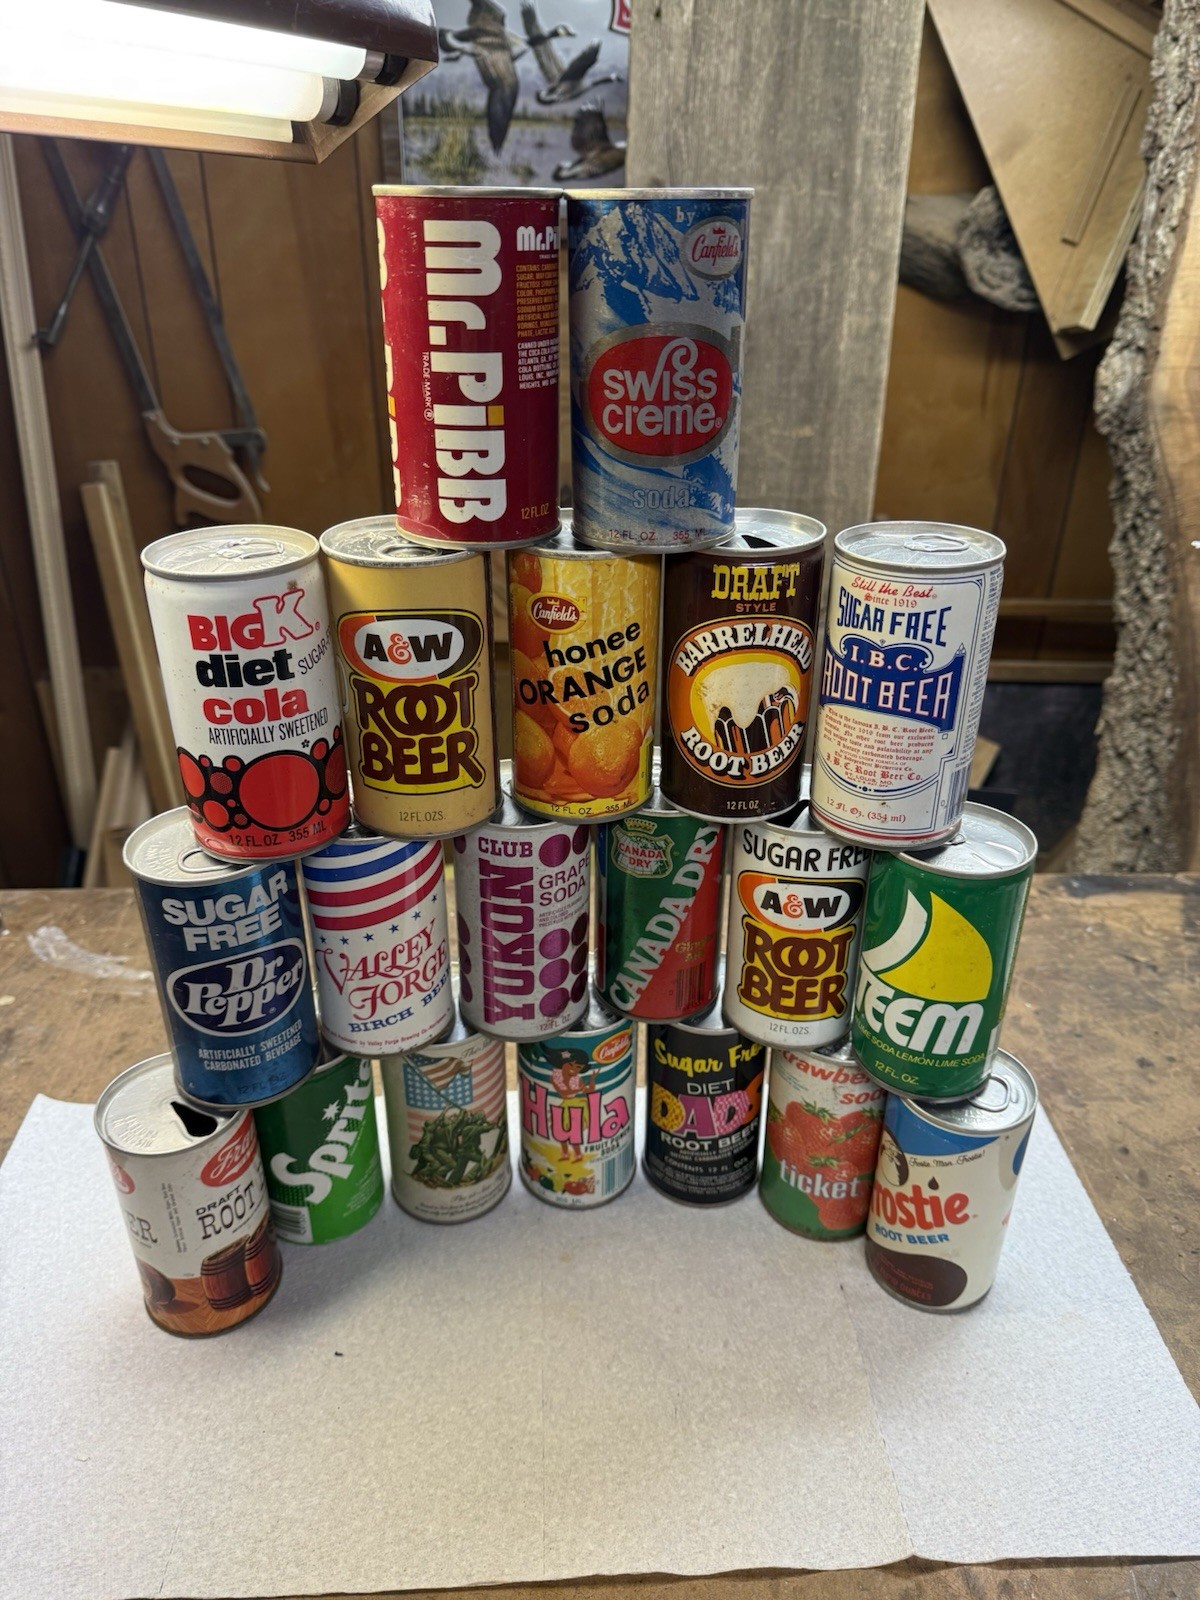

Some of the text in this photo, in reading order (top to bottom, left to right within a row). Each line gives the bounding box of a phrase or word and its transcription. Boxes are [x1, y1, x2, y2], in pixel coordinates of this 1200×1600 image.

[676, 206, 695, 226] by
[632, 485, 691, 509] soda
[609, 529, 619, 539] 12
[673, 529, 690, 540] 355
[711, 562, 800, 600] DRAFT
[851, 576, 934, 599] Still the Best
[864, 592, 917, 608] Since 1919
[532, 602, 579, 625] Canfield's
[735, 602, 777, 613] STYLE
[837, 586, 953, 648] SUGAR FREE
[363, 631, 454, 665] A&W
[542, 621, 641, 668] honee
[675, 622, 812, 677] BARRELHEAD
[195, 648, 296, 688] diet
[518, 645, 647, 705] ORANGE
[821, 649, 954, 720] ROOT BEER
[202, 687, 310, 725] cola
[352, 676, 477, 737] ROOT
[569, 680, 650, 734] soda
[208, 707, 329, 746] ARTIFICIALLY SWEETENED
[361, 730, 484, 785] BEER
[680, 720, 805, 778] ROOT BEER
[855, 764, 878, 777] Root
[880, 769, 904, 780] Beer
[907, 772, 924, 781] Co.
[550, 804, 561, 813] 12
[605, 803, 620, 813] 355
[726, 800, 760, 810] 12 FL OZ
[826, 796, 835, 806] 12
[229, 835, 243, 846] 12
[288, 826, 310, 843] 355
[313, 819, 328, 836] ML
[478, 836, 533, 858] CLUB
[618, 842, 664, 860] CANADA
[742, 828, 821, 872] SUGAR
[538, 851, 589, 890] GRAPE
[628, 856, 652, 869] DRY
[161, 869, 289, 926] SUGAR
[539, 875, 586, 907] SODA
[760, 890, 842, 919] A&W
[182, 901, 283, 952] FREE
[609, 895, 696, 1012] CANADA
[672, 823, 722, 892] DRY
[315, 917, 436, 995] VALLEY
[478, 857, 535, 1026] YUKON
[744, 921, 853, 977] ROOT
[183, 957, 303, 1028] Pepper
[219, 955, 285, 994] Dr
[740, 965, 846, 1016] BEER
[198, 1044, 256, 1060] ARTIFICIALLY
[260, 1019, 303, 1051] SWEETENED
[348, 1007, 414, 1033] BIRCH
[204, 1055, 261, 1072] CARBONATED
[265, 1032, 302, 1062] BEVERAGE
[654, 1038, 723, 1078] Sugar
[780, 1049, 872, 1085] trawbe
[871, 1035, 896, 1057] SODA
[895, 1049, 935, 1067] LEMON
[935, 1059, 960, 1068] LIME
[960, 1052, 986, 1067] SODA
[874, 1060, 885, 1073] 12
[687, 1078, 735, 1096] DIET
[521, 1074, 631, 1146] Hula
[270, 1058, 372, 1205] Sprite
[660, 1130, 713, 1152] ROOT
[718, 1119, 760, 1150] BEER
[779, 1158, 861, 1199] ticket
[195, 1183, 241, 1216] DRAFT
[198, 1181, 255, 1241] ROOT
[871, 1181, 970, 1231] rostie
[874, 1222, 951, 1245] ROOT BEER
